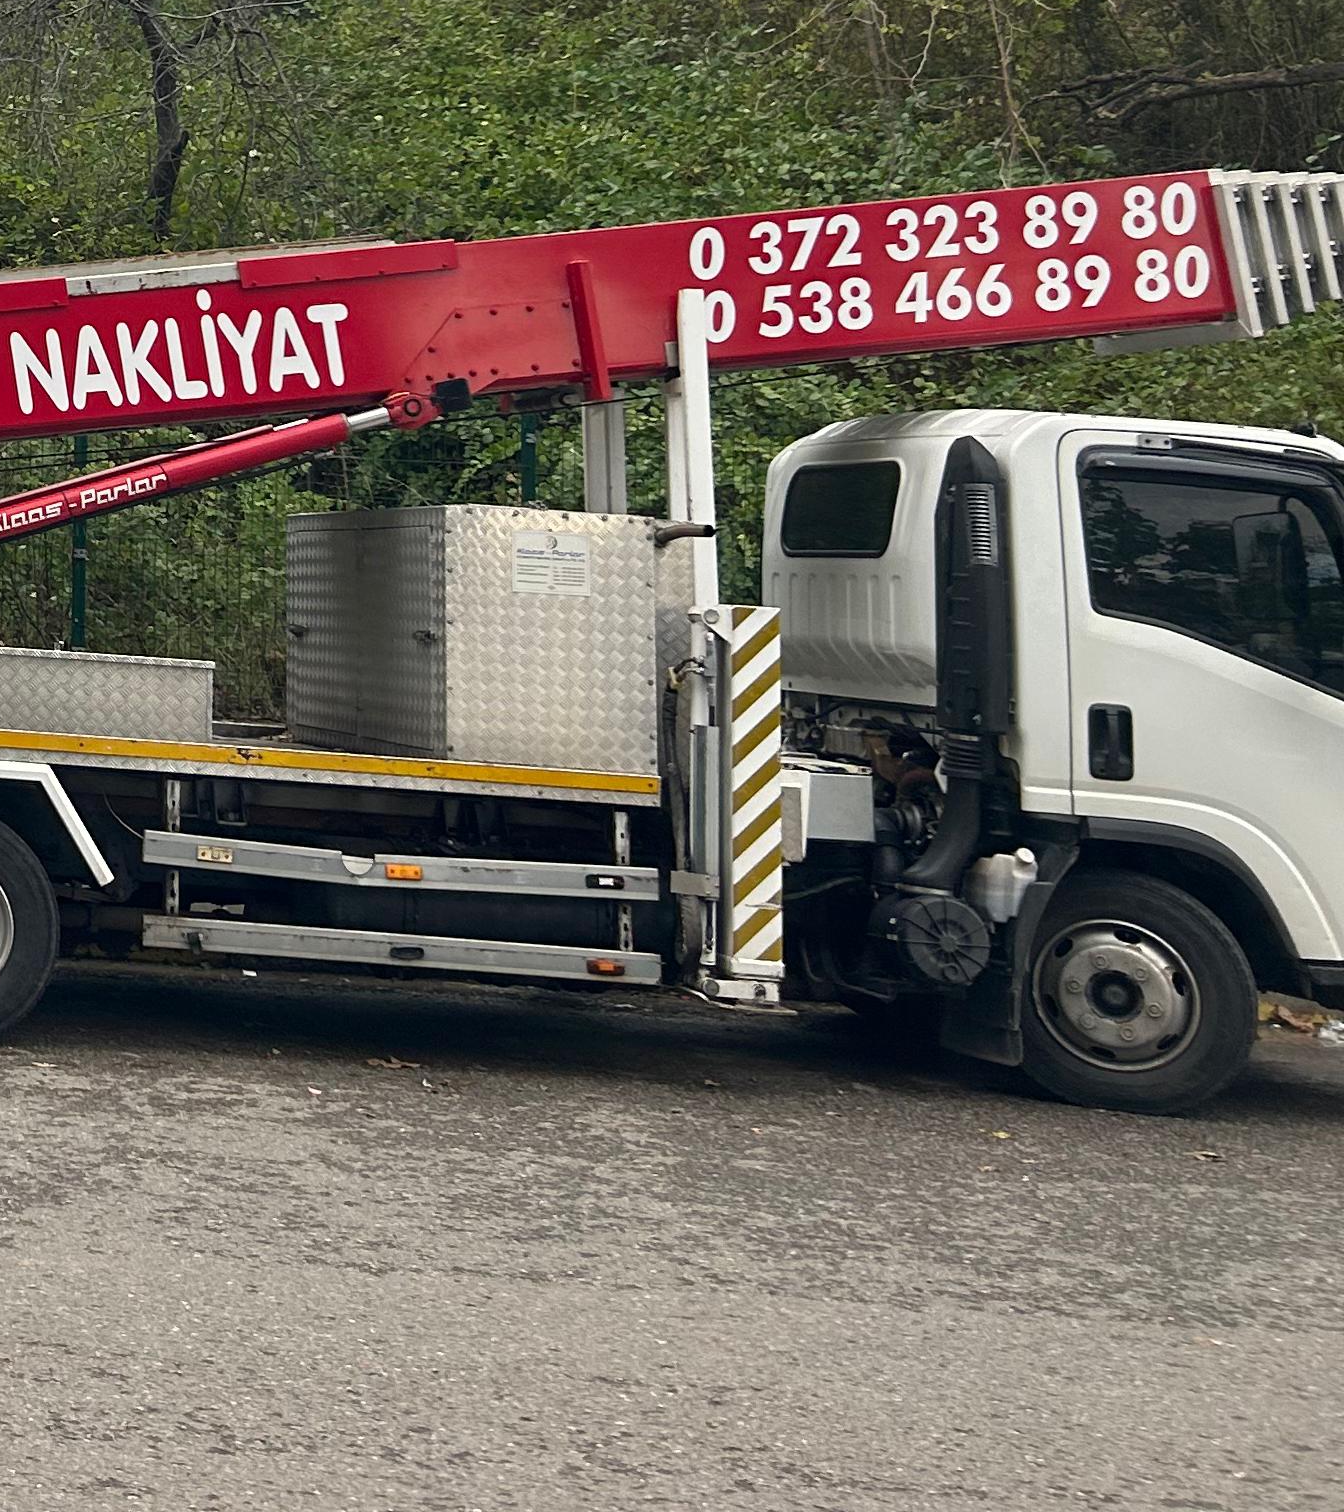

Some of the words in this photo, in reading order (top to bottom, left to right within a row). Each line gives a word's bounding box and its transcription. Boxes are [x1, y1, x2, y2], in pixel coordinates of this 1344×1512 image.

[689, 226, 725, 281] 0
[748, 213, 862, 275] 372
[885, 200, 1000, 262] 323
[1022, 191, 1098, 249] 89
[1121, 182, 1197, 240] 80
[704, 289, 737, 344] 0
[758, 277, 874, 338] 538
[895, 263, 1013, 323] 466
[1034, 254, 1111, 312] 89
[1134, 245, 1210, 303] 80
[79, 474, 167, 510] Parlar
